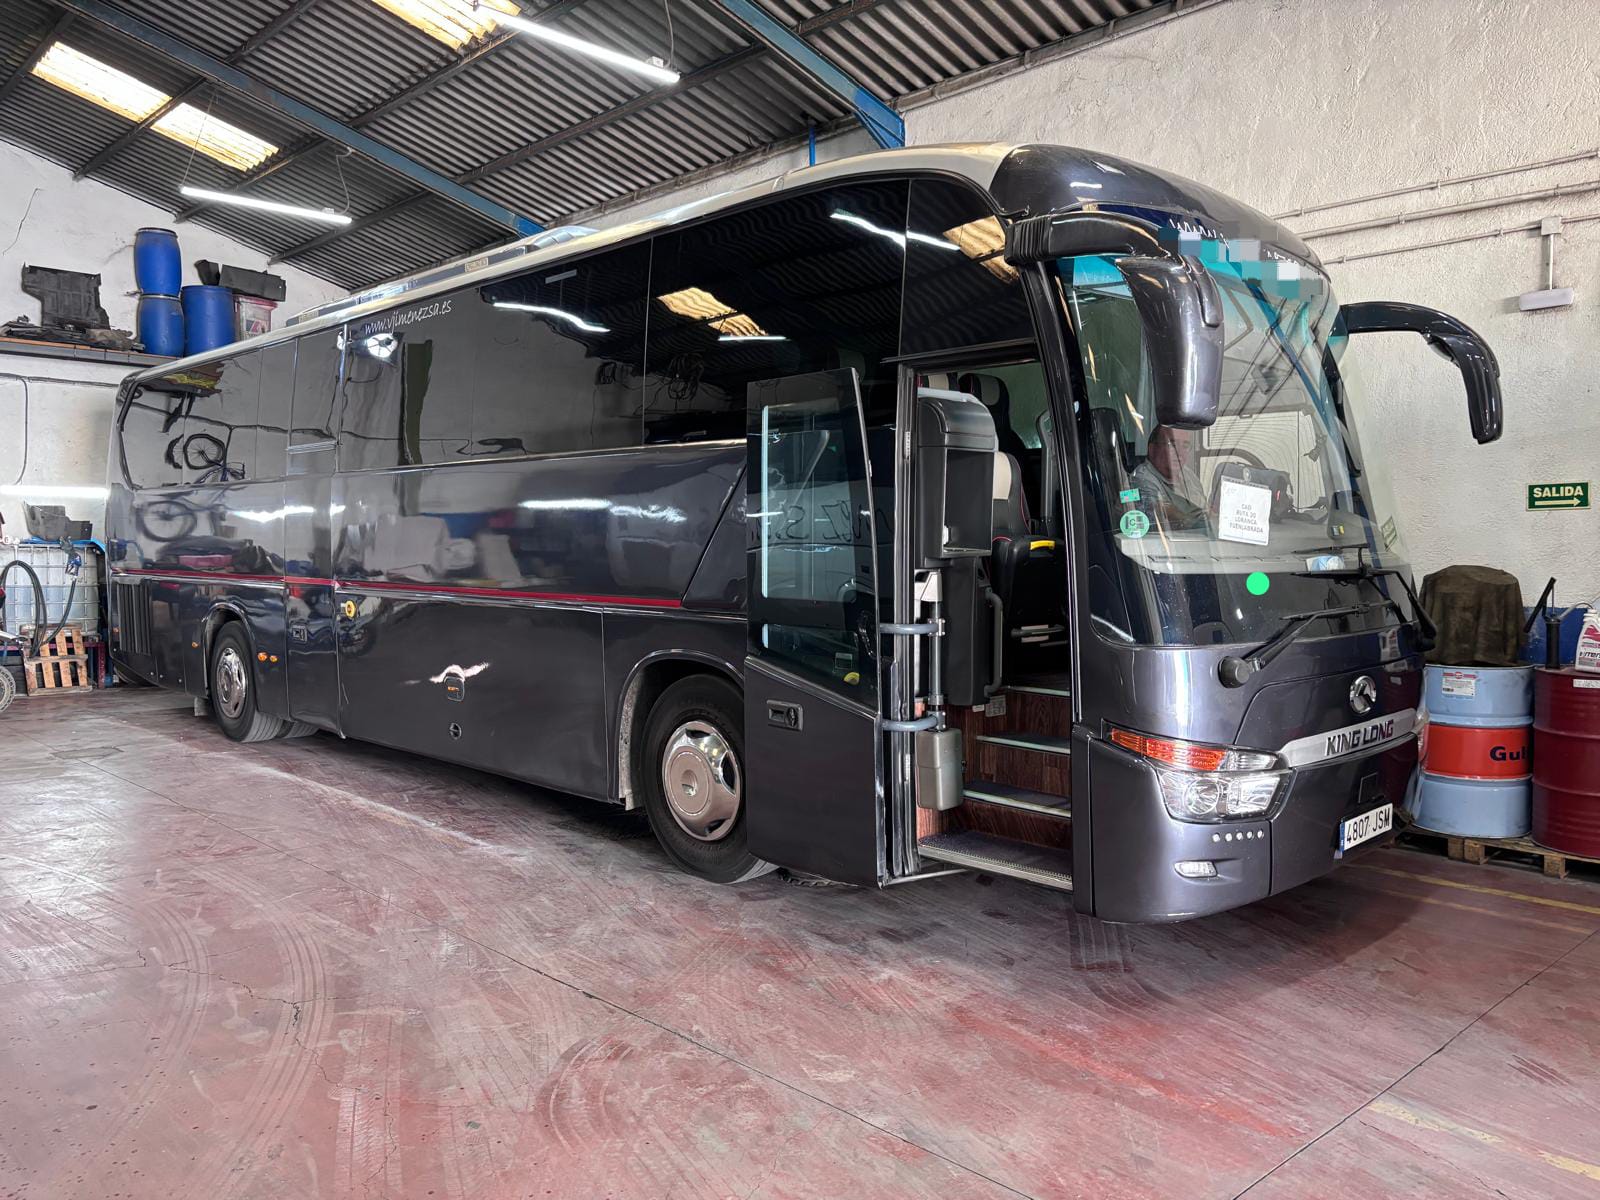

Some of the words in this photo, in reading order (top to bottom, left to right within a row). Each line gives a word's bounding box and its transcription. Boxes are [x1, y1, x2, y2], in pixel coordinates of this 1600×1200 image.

[365, 300, 452, 335] www.vjimenezsa.es
[1533, 485, 1584, 498] SALIDA
[1229, 522, 1264, 533] FUENLABRADA
[1325, 728, 1360, 757] KING
[1363, 719, 1394, 745] LONG
[1346, 815, 1370, 844] 4807
[1372, 807, 1391, 833] JSM
